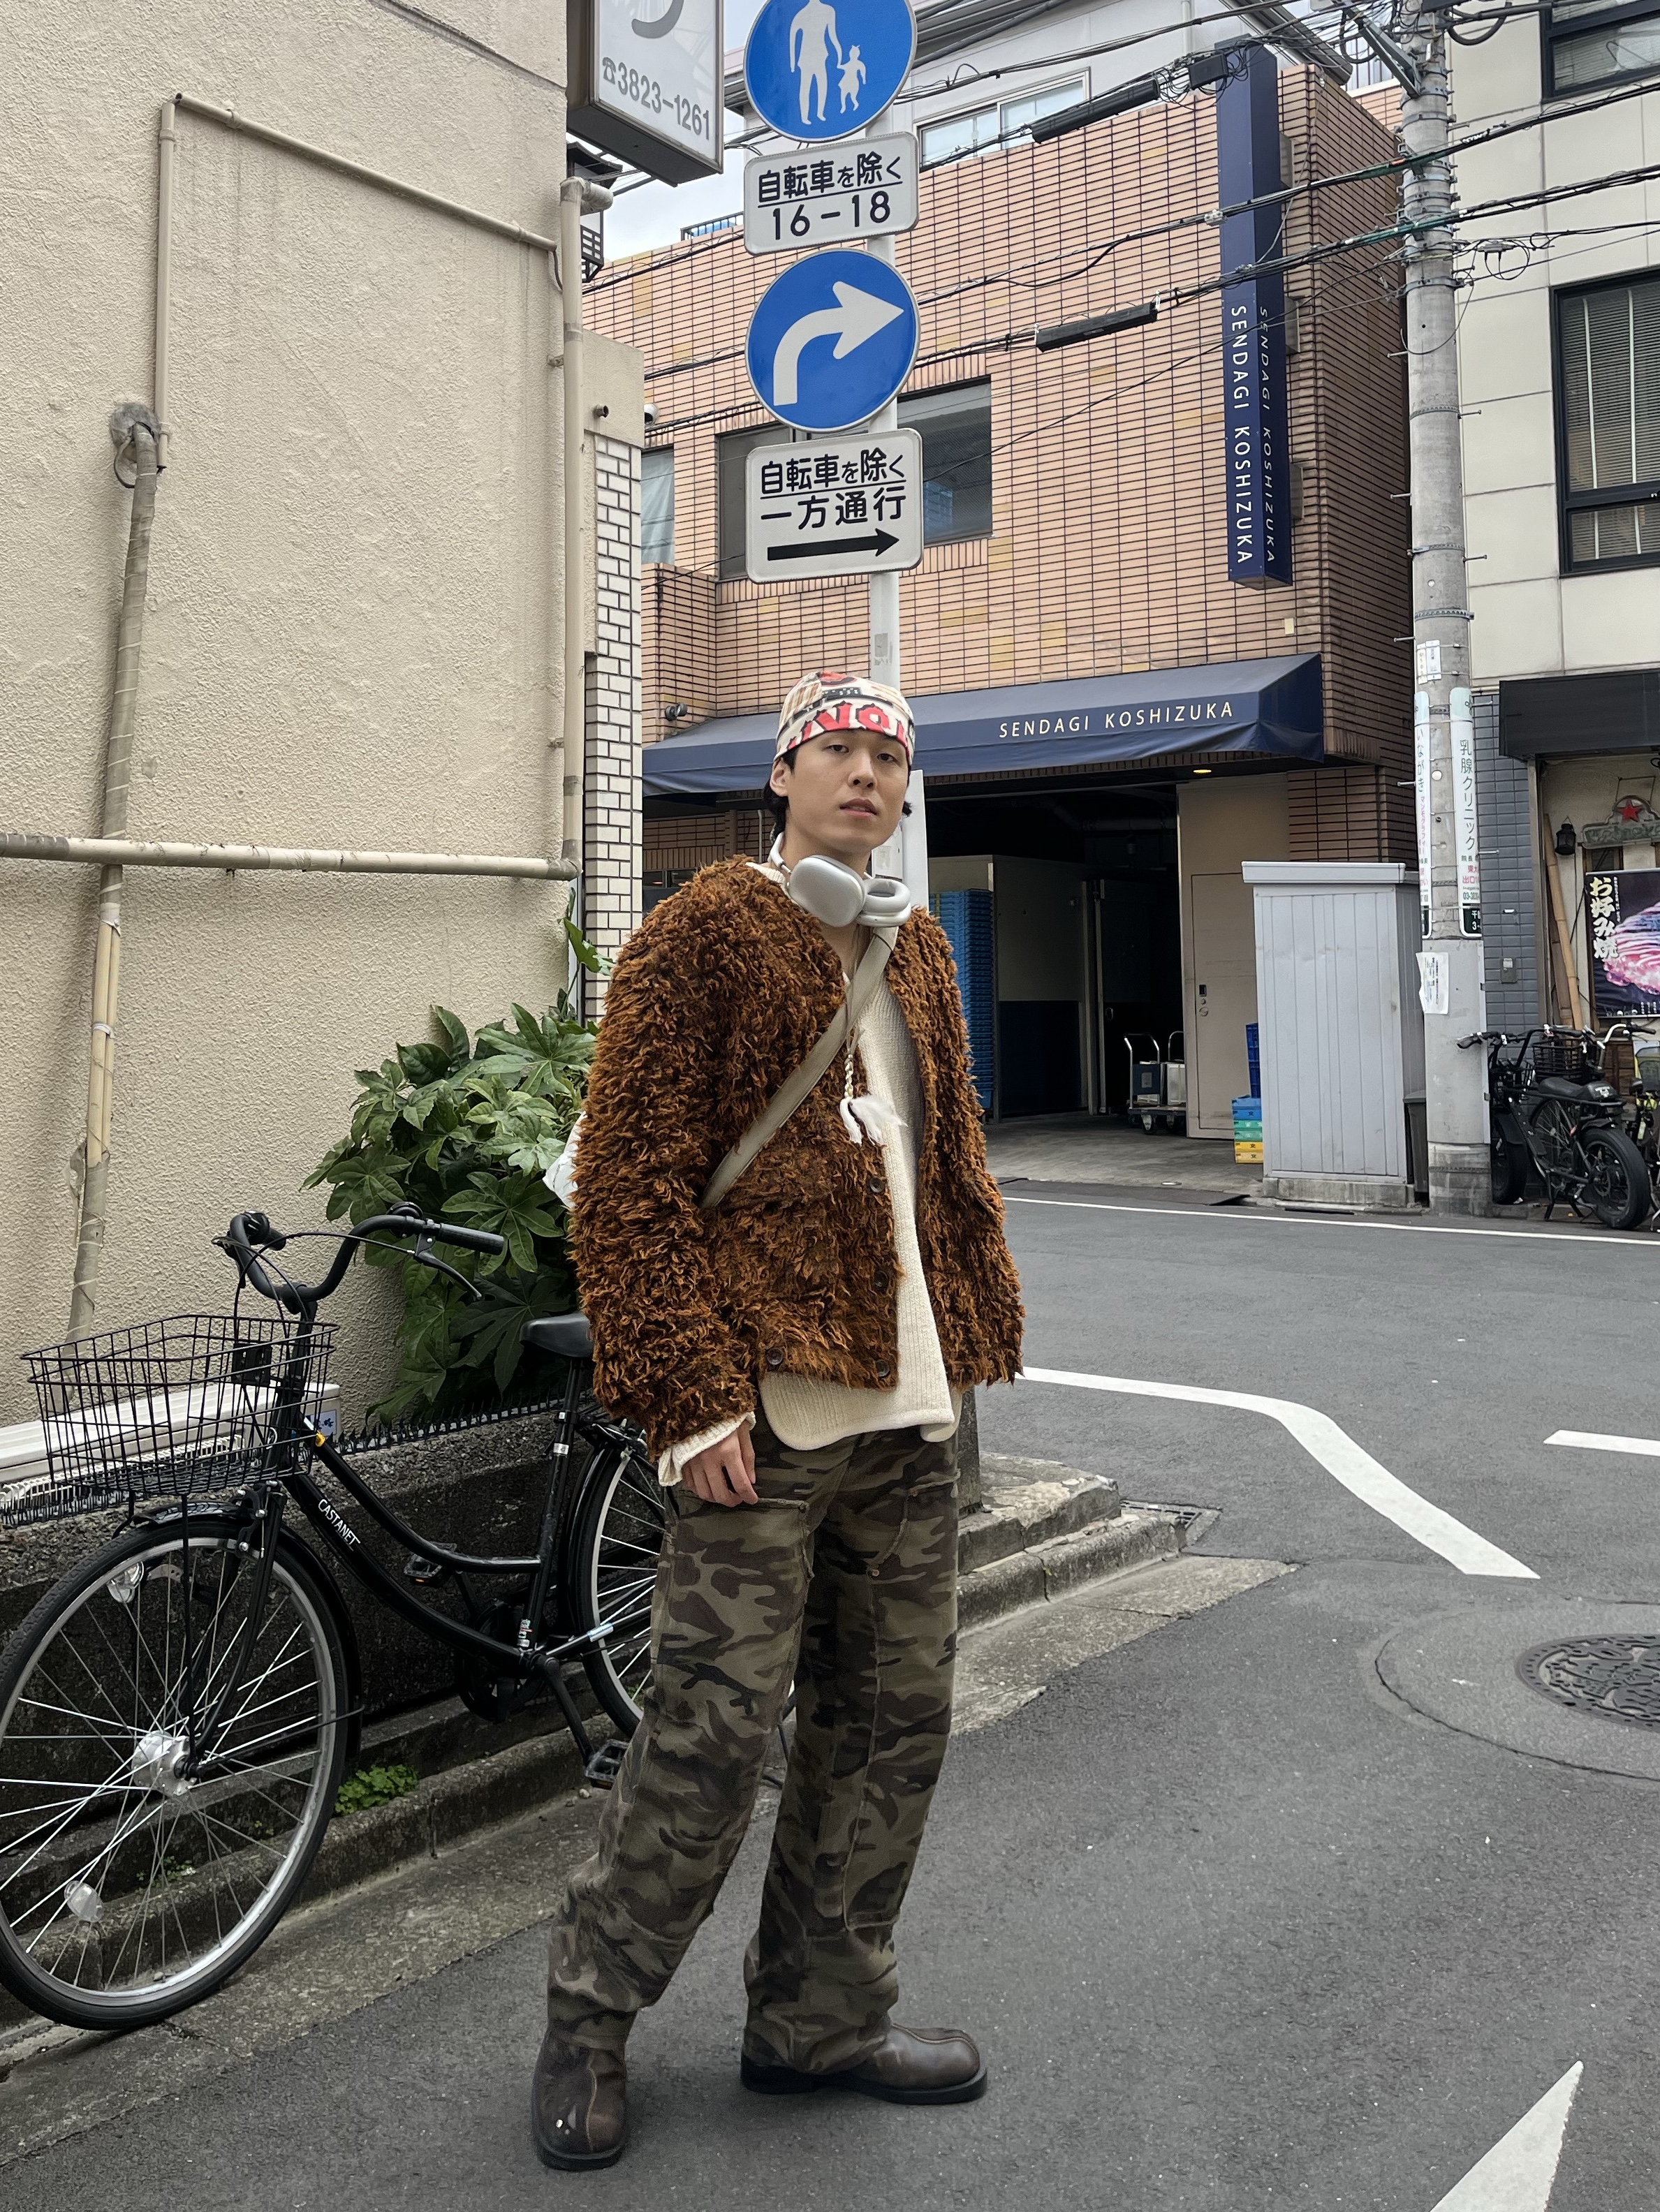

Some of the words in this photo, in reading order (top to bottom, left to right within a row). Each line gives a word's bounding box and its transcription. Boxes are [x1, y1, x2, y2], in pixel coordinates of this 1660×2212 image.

[617, 66, 710, 140] 3823-1261
[758, 152, 902, 203] 自転車を除く
[1231, 306, 1249, 409] SENDAGI
[1260, 307, 1270, 410] SENDAGI
[761, 447, 905, 494] 自転車を除く
[761, 486, 906, 530] 一方通行
[1234, 427, 1253, 563] KOSHIZUKA
[1263, 427, 1275, 561] KOSHIZUKA
[999, 716, 1089, 738] SENDAGI
[1106, 701, 1233, 728] KOSHIZUKA
[1460, 739, 1475, 850] 乳腺クリニック
[1589, 876, 1619, 959] お好み焼
[318, 1498, 361, 1544] CASTANET
